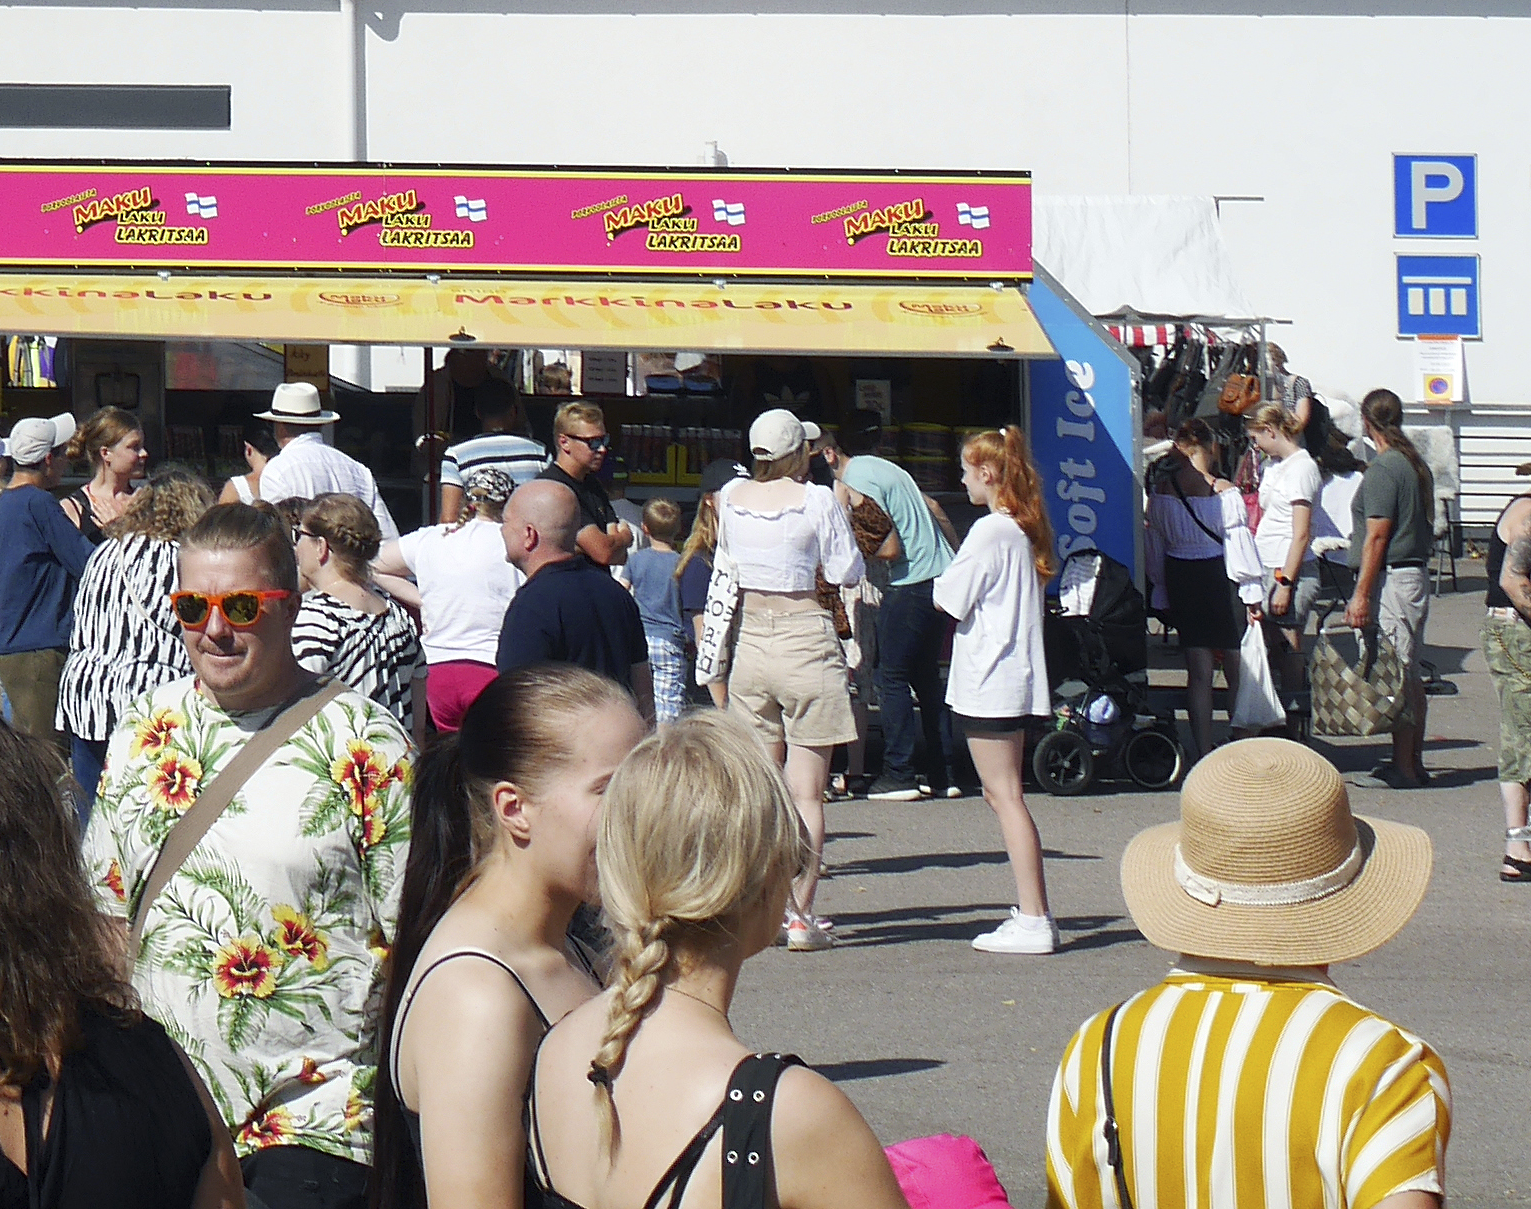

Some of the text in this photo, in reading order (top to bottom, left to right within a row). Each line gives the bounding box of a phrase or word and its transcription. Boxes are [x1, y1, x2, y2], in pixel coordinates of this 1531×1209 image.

[1411, 161, 1464, 229] P
[73, 187, 152, 225] MAKU
[338, 189, 416, 228] MAKU
[604, 194, 683, 231] MAKU
[117, 211, 165, 225] LAKU
[383, 214, 431, 227] LAKU
[649, 218, 697, 232] LAKU
[844, 198, 924, 237] MAKU
[115, 227, 208, 244] LAKRITSAA
[380, 229, 474, 247] LAKRITSAA
[890, 223, 938, 237] LAKU
[646, 233, 741, 251] LAKRITSAA
[887, 238, 982, 256] LAKRITSAA
[1056, 359, 1096, 442] Ice
